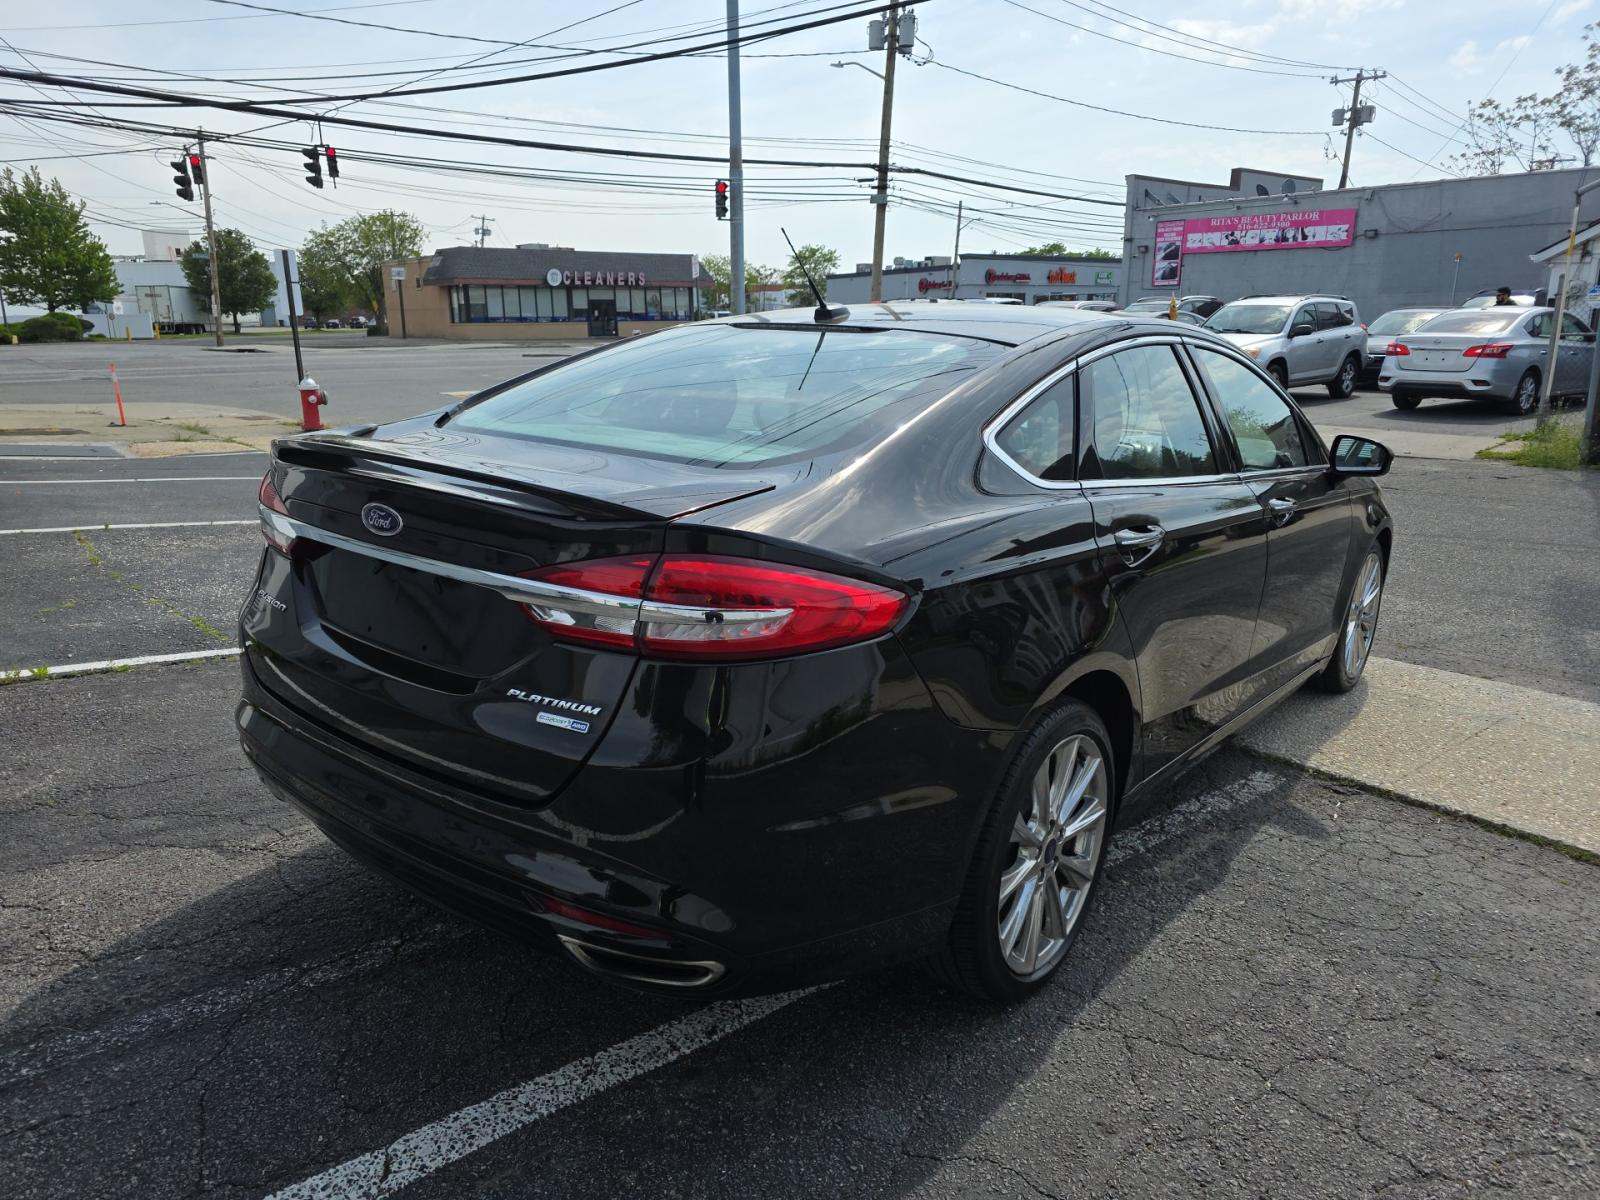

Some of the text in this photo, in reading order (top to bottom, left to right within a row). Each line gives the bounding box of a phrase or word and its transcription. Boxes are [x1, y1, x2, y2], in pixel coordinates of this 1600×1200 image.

[1210, 211, 1320, 226] RITA'S BEAUTY PARLOR
[563, 270, 646, 286] CLEANERS
[368, 509, 392, 528] Ford
[506, 688, 602, 715] PLATINUM
